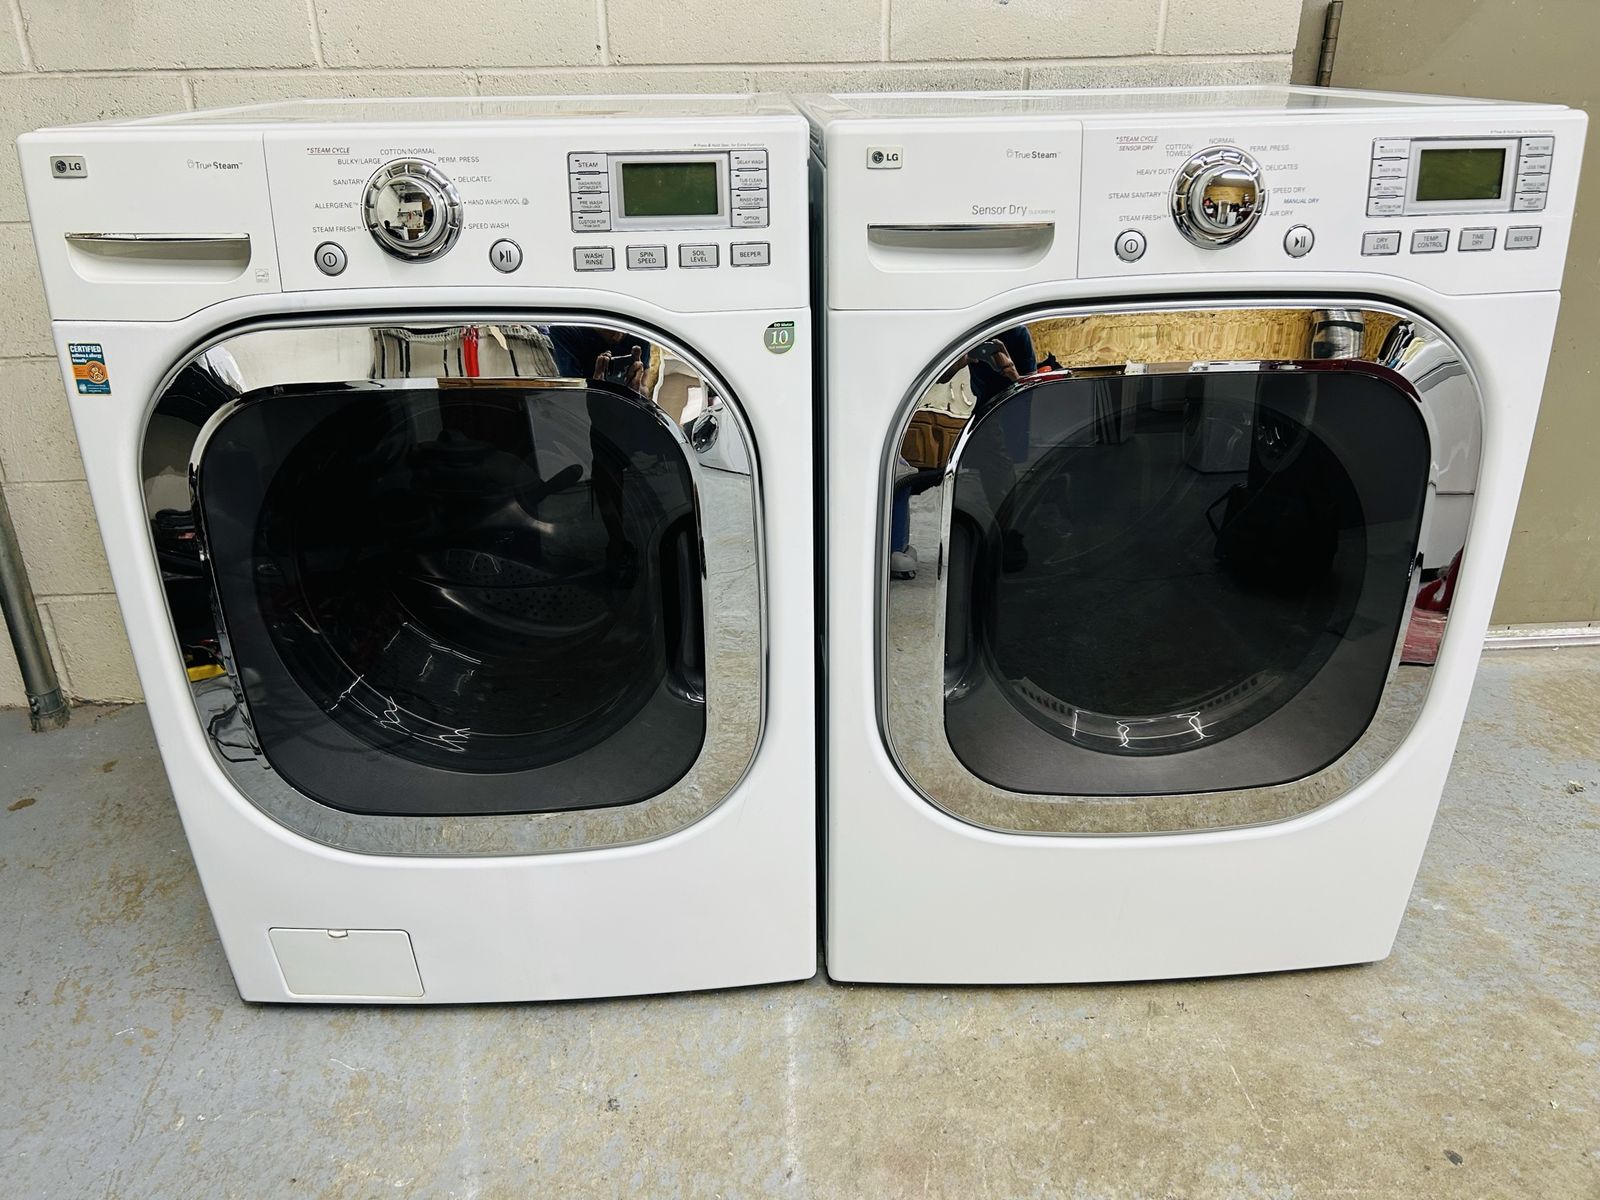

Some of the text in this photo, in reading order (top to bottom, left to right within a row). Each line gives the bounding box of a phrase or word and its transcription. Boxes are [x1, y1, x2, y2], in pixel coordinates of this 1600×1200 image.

[886, 153, 899, 162] LG
[69, 162, 81, 171] LG
[1265, 163, 1298, 171] DELICATES
[972, 205, 1007, 215] Sensor
[1009, 204, 1028, 216] Dry
[771, 329, 788, 345] 10
[69, 345, 102, 353] CERTIFIED
